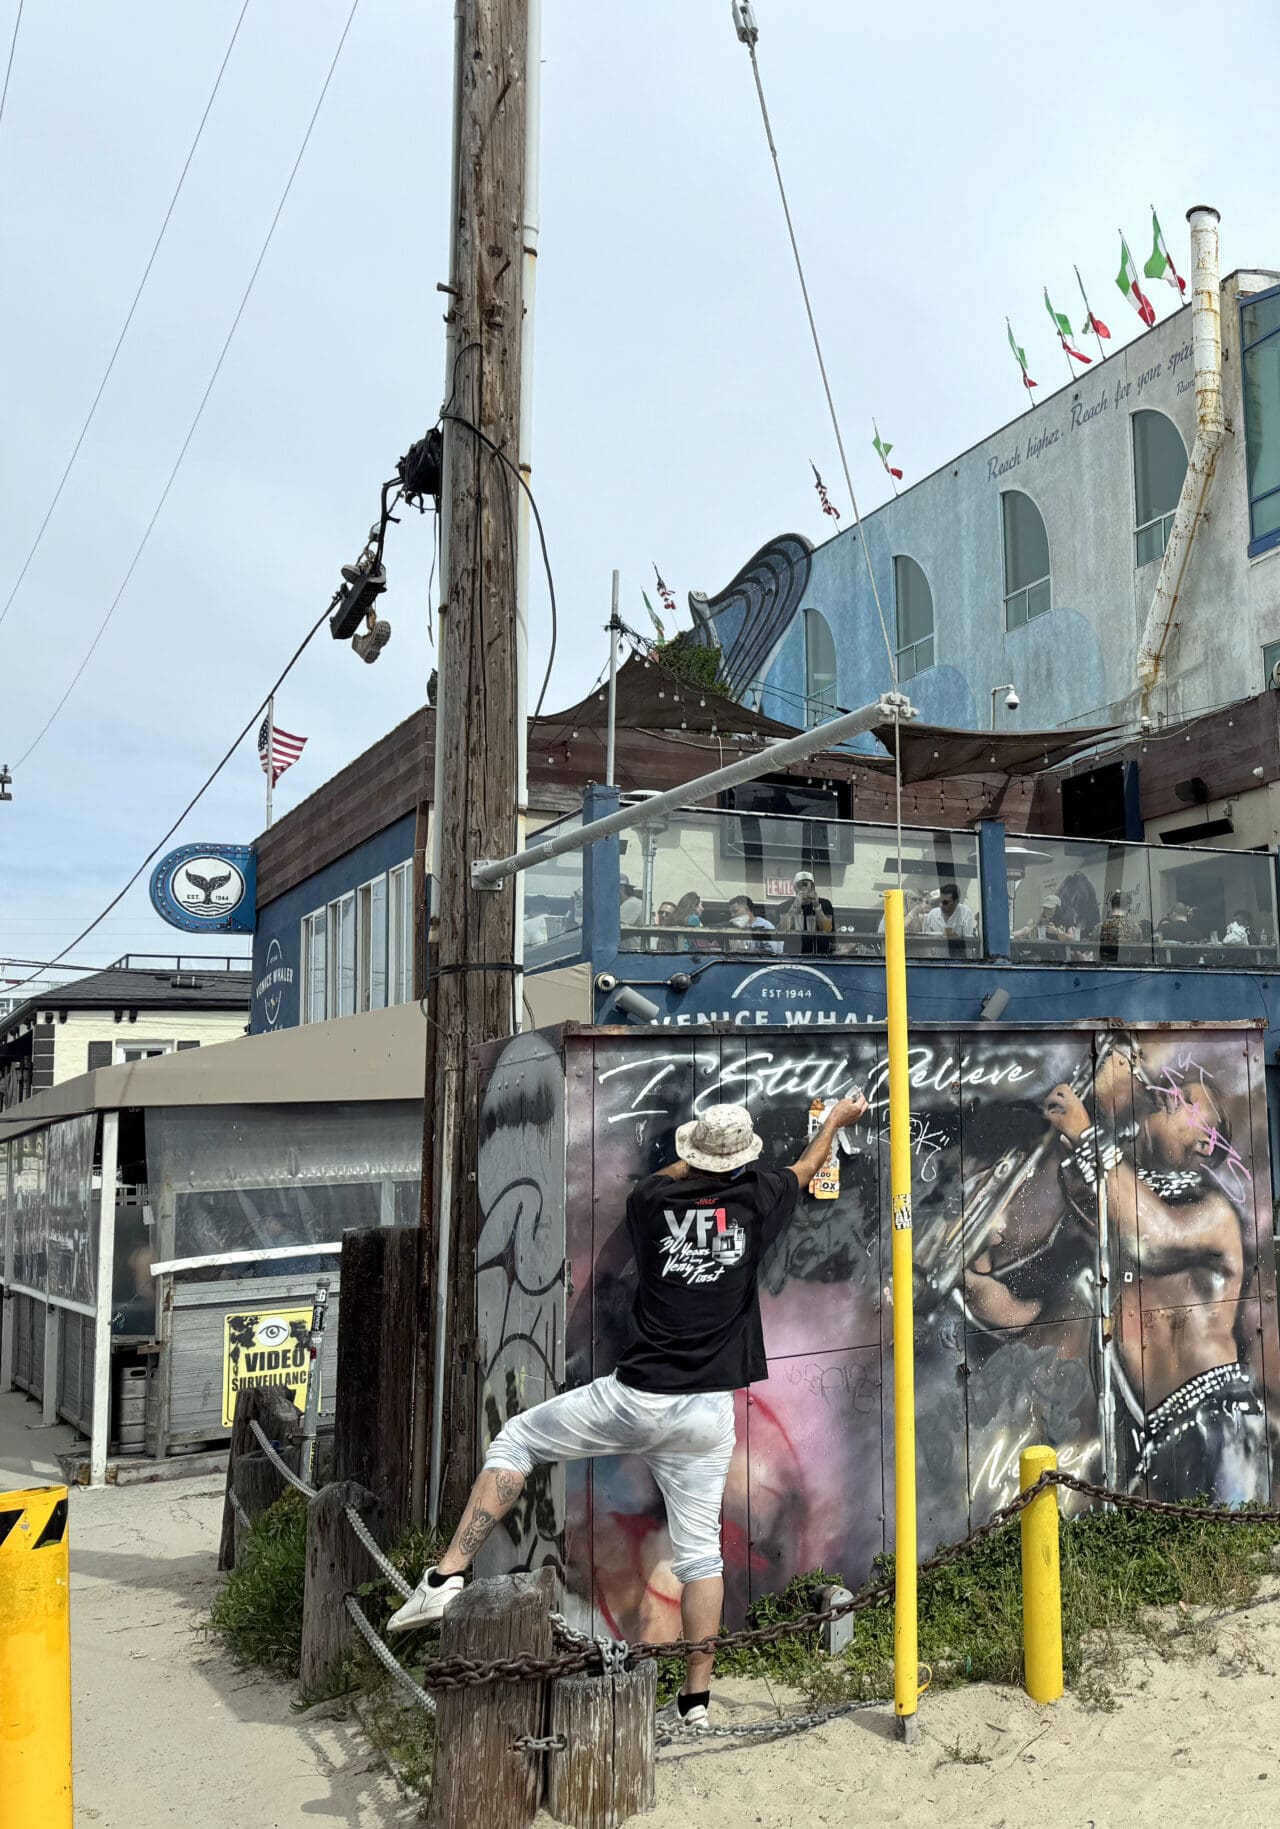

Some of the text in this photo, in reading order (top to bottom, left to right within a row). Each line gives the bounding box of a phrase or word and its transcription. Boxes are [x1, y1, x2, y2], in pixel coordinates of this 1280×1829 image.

[987, 446, 1021, 482] Reach
[1070, 389, 1108, 431] Reach
[1115, 379, 1132, 410] for
[1138, 363, 1161, 395] your
[761, 988, 812, 1000] EST 1944
[694, 1052, 853, 1116] Still
[663, 1207, 727, 1248] VF1
[244, 1347, 305, 1373] VIDEO
[231, 1370, 307, 1392] SURVEILLANC
